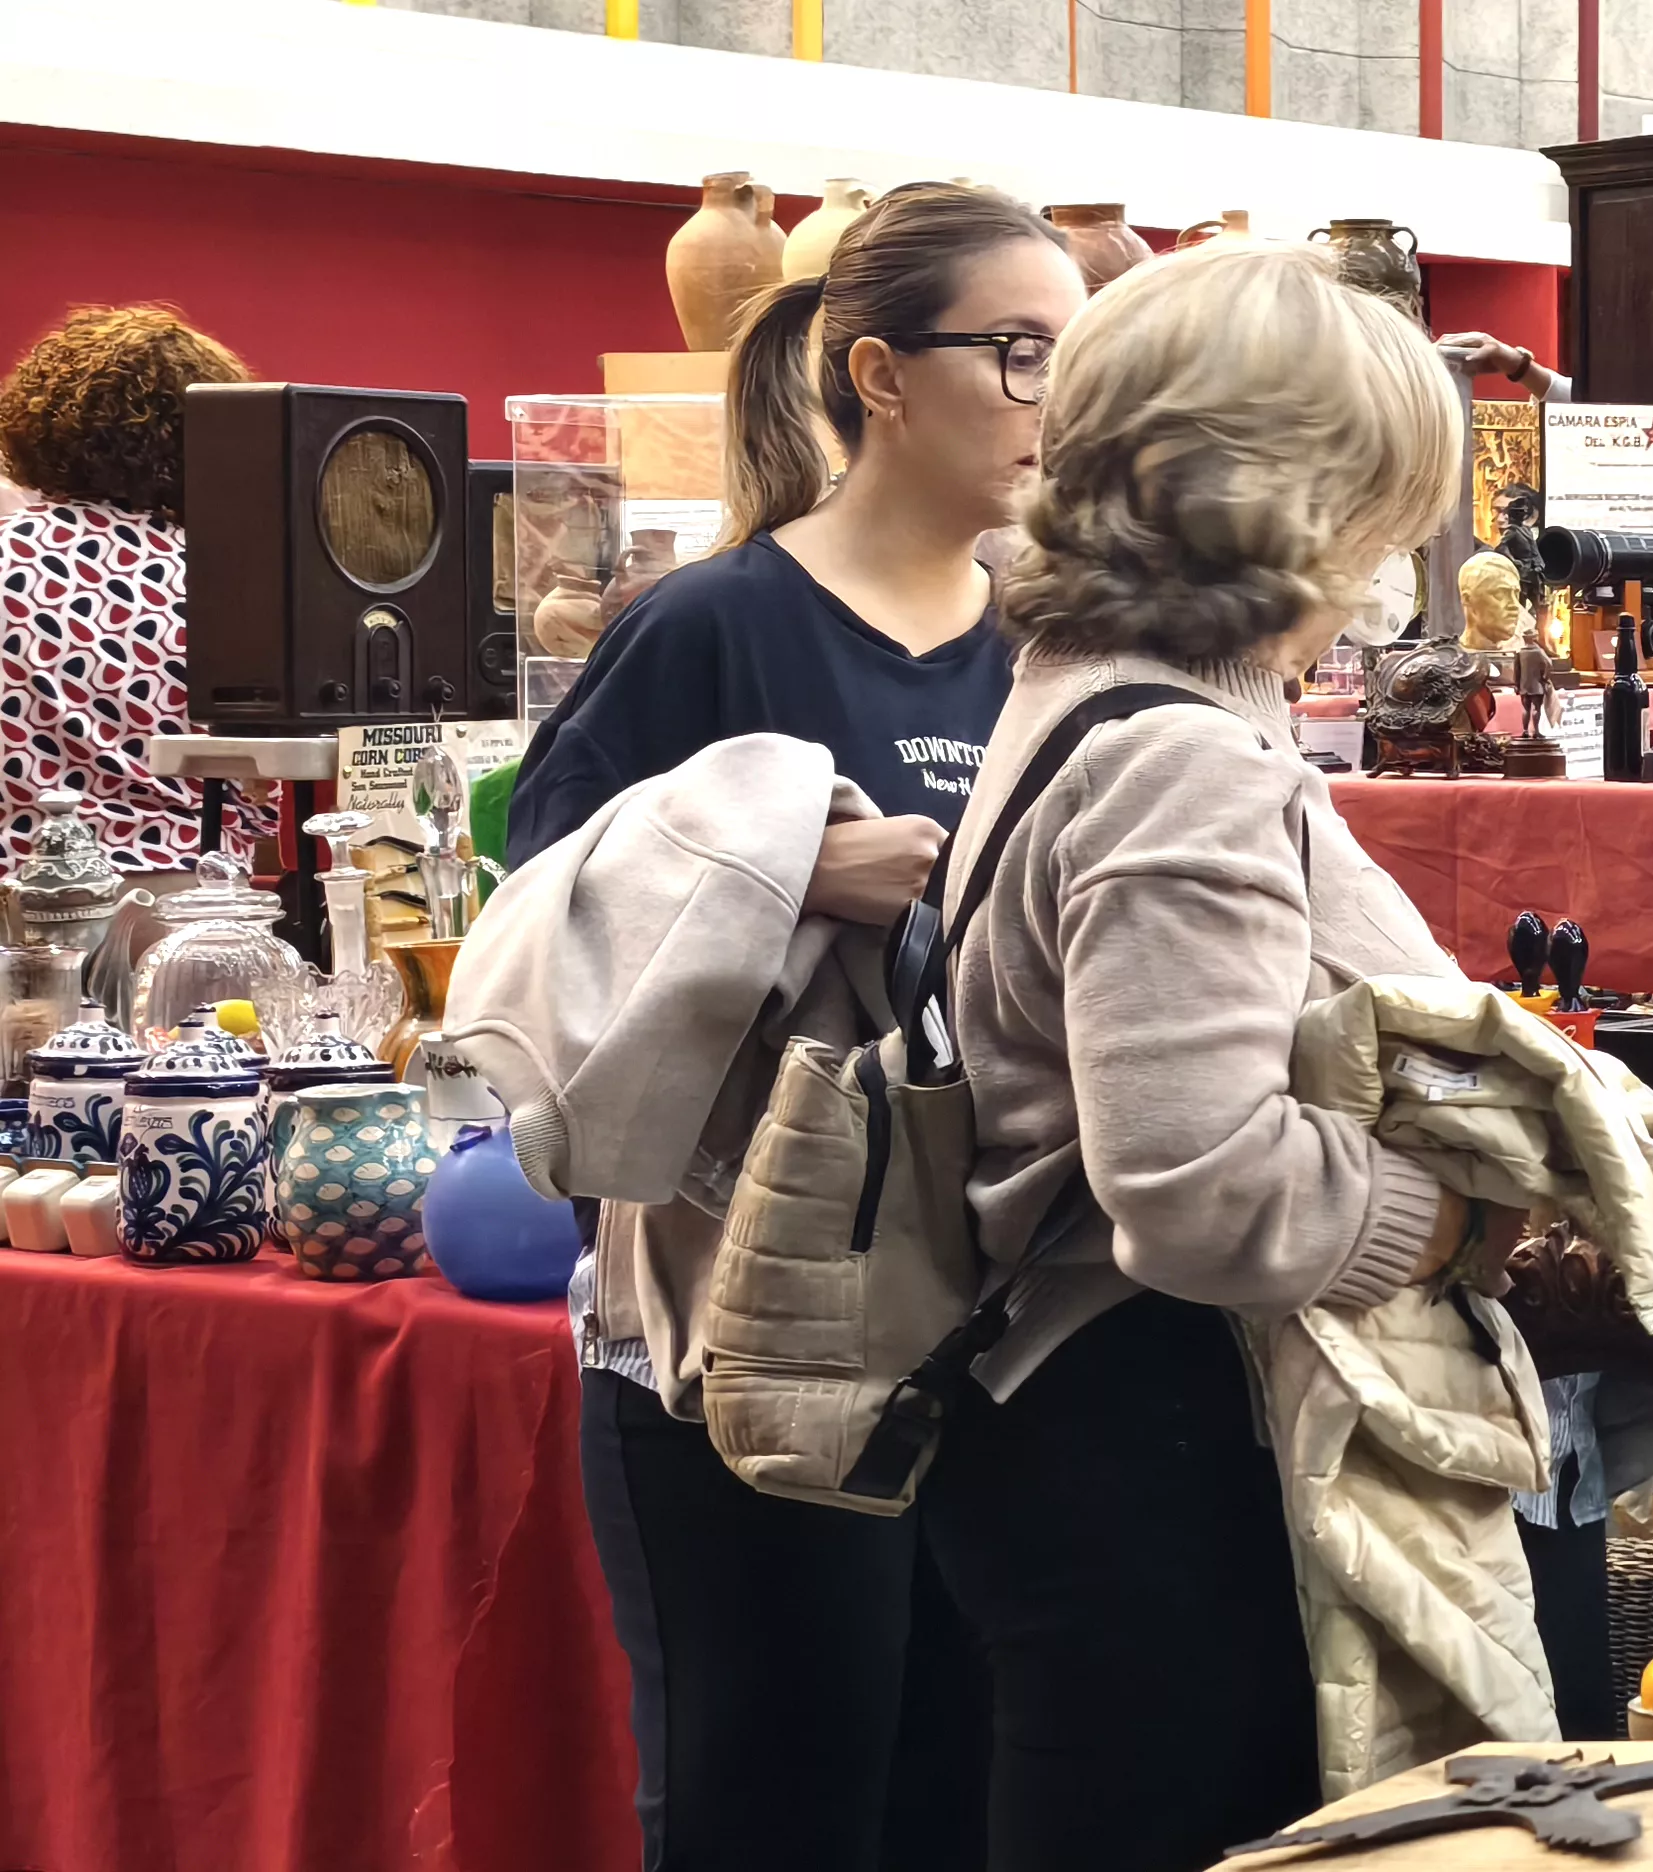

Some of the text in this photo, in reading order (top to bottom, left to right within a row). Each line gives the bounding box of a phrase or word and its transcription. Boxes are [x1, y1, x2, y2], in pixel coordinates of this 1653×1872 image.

[363, 724, 443, 747] MISSOURI
[352, 748, 389, 767] CORN
[894, 736, 988, 768] DOWNTO
[921, 768, 973, 796] New H
